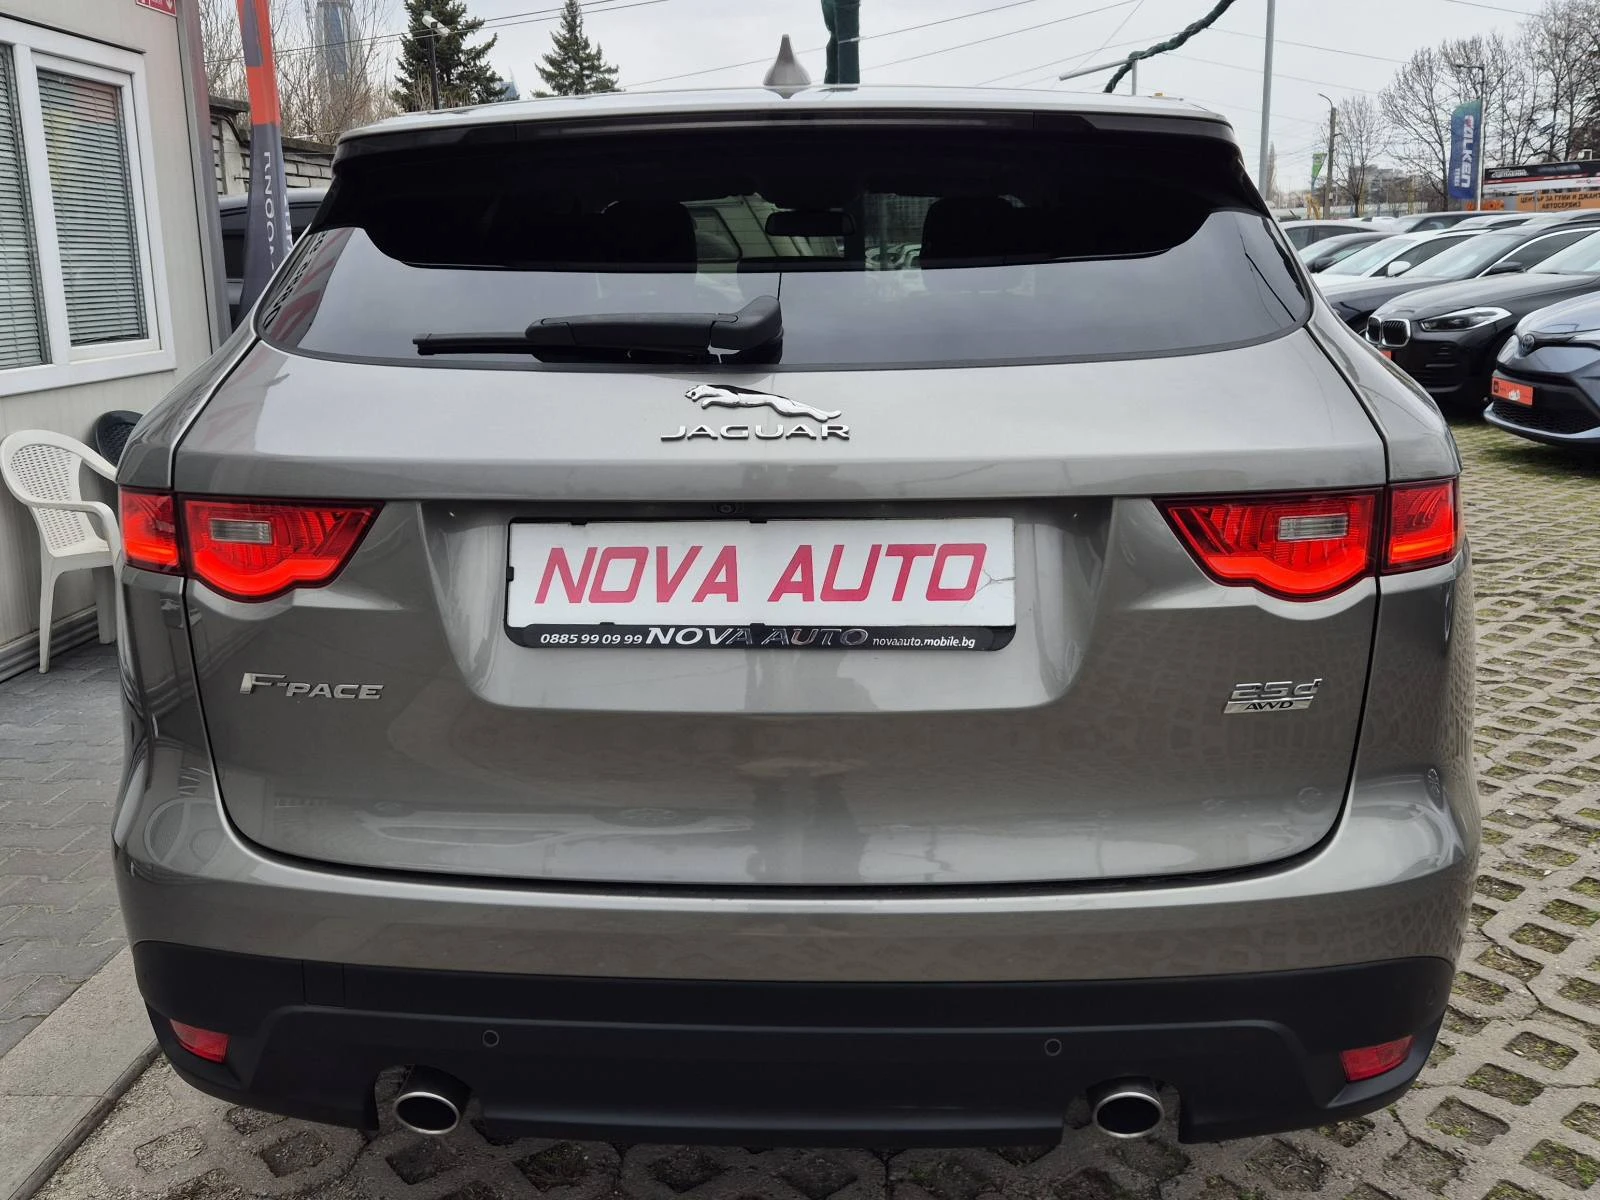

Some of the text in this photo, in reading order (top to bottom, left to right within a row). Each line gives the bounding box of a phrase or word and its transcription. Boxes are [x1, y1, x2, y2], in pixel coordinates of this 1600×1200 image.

[660, 423, 850, 442] JAGUAR
[534, 543, 988, 604] NOVA AUTO
[540, 627, 976, 649] 0885 99 09 99 NOVA AUTO novaauto.mobile.bg
[239, 672, 385, 700] F-PACE
[1231, 678, 1323, 700] 25d
[1244, 701, 1294, 711] AWD
